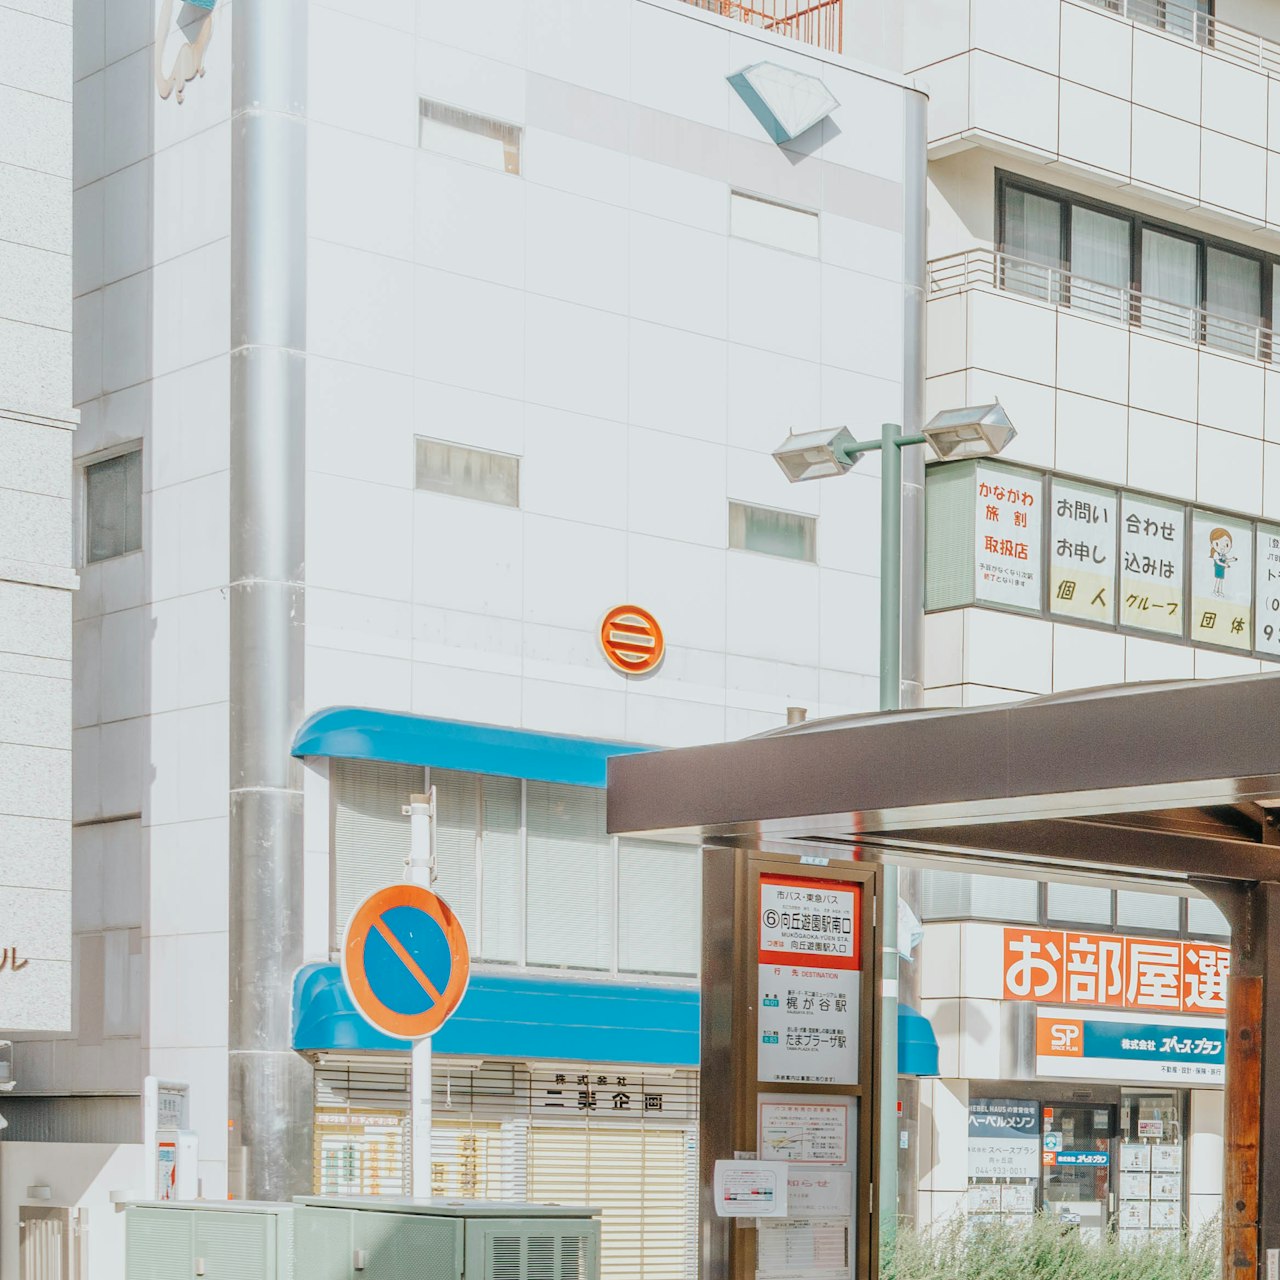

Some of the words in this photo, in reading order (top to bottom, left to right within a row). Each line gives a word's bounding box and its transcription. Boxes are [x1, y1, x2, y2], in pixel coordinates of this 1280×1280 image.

[979, 482, 1034, 507] かながわ
[984, 535, 1029, 561] 取扱店
[1125, 590, 1178, 617] グループ
[776, 890, 838, 905] 市バス・東急バス
[781, 911, 851, 934] 向丘遊園駅南口
[801, 971, 839, 980] DESTINATION
[786, 996, 847, 1013] 梶が谷駅
[786, 1033, 847, 1049] たまプラーザ駅
[1051, 1024, 1079, 1046] SP
[1121, 1038, 1156, 1051] 株式会社
[1159, 1035, 1222, 1055] スペース・プラン
[555, 1073, 627, 1088] 株式会社
